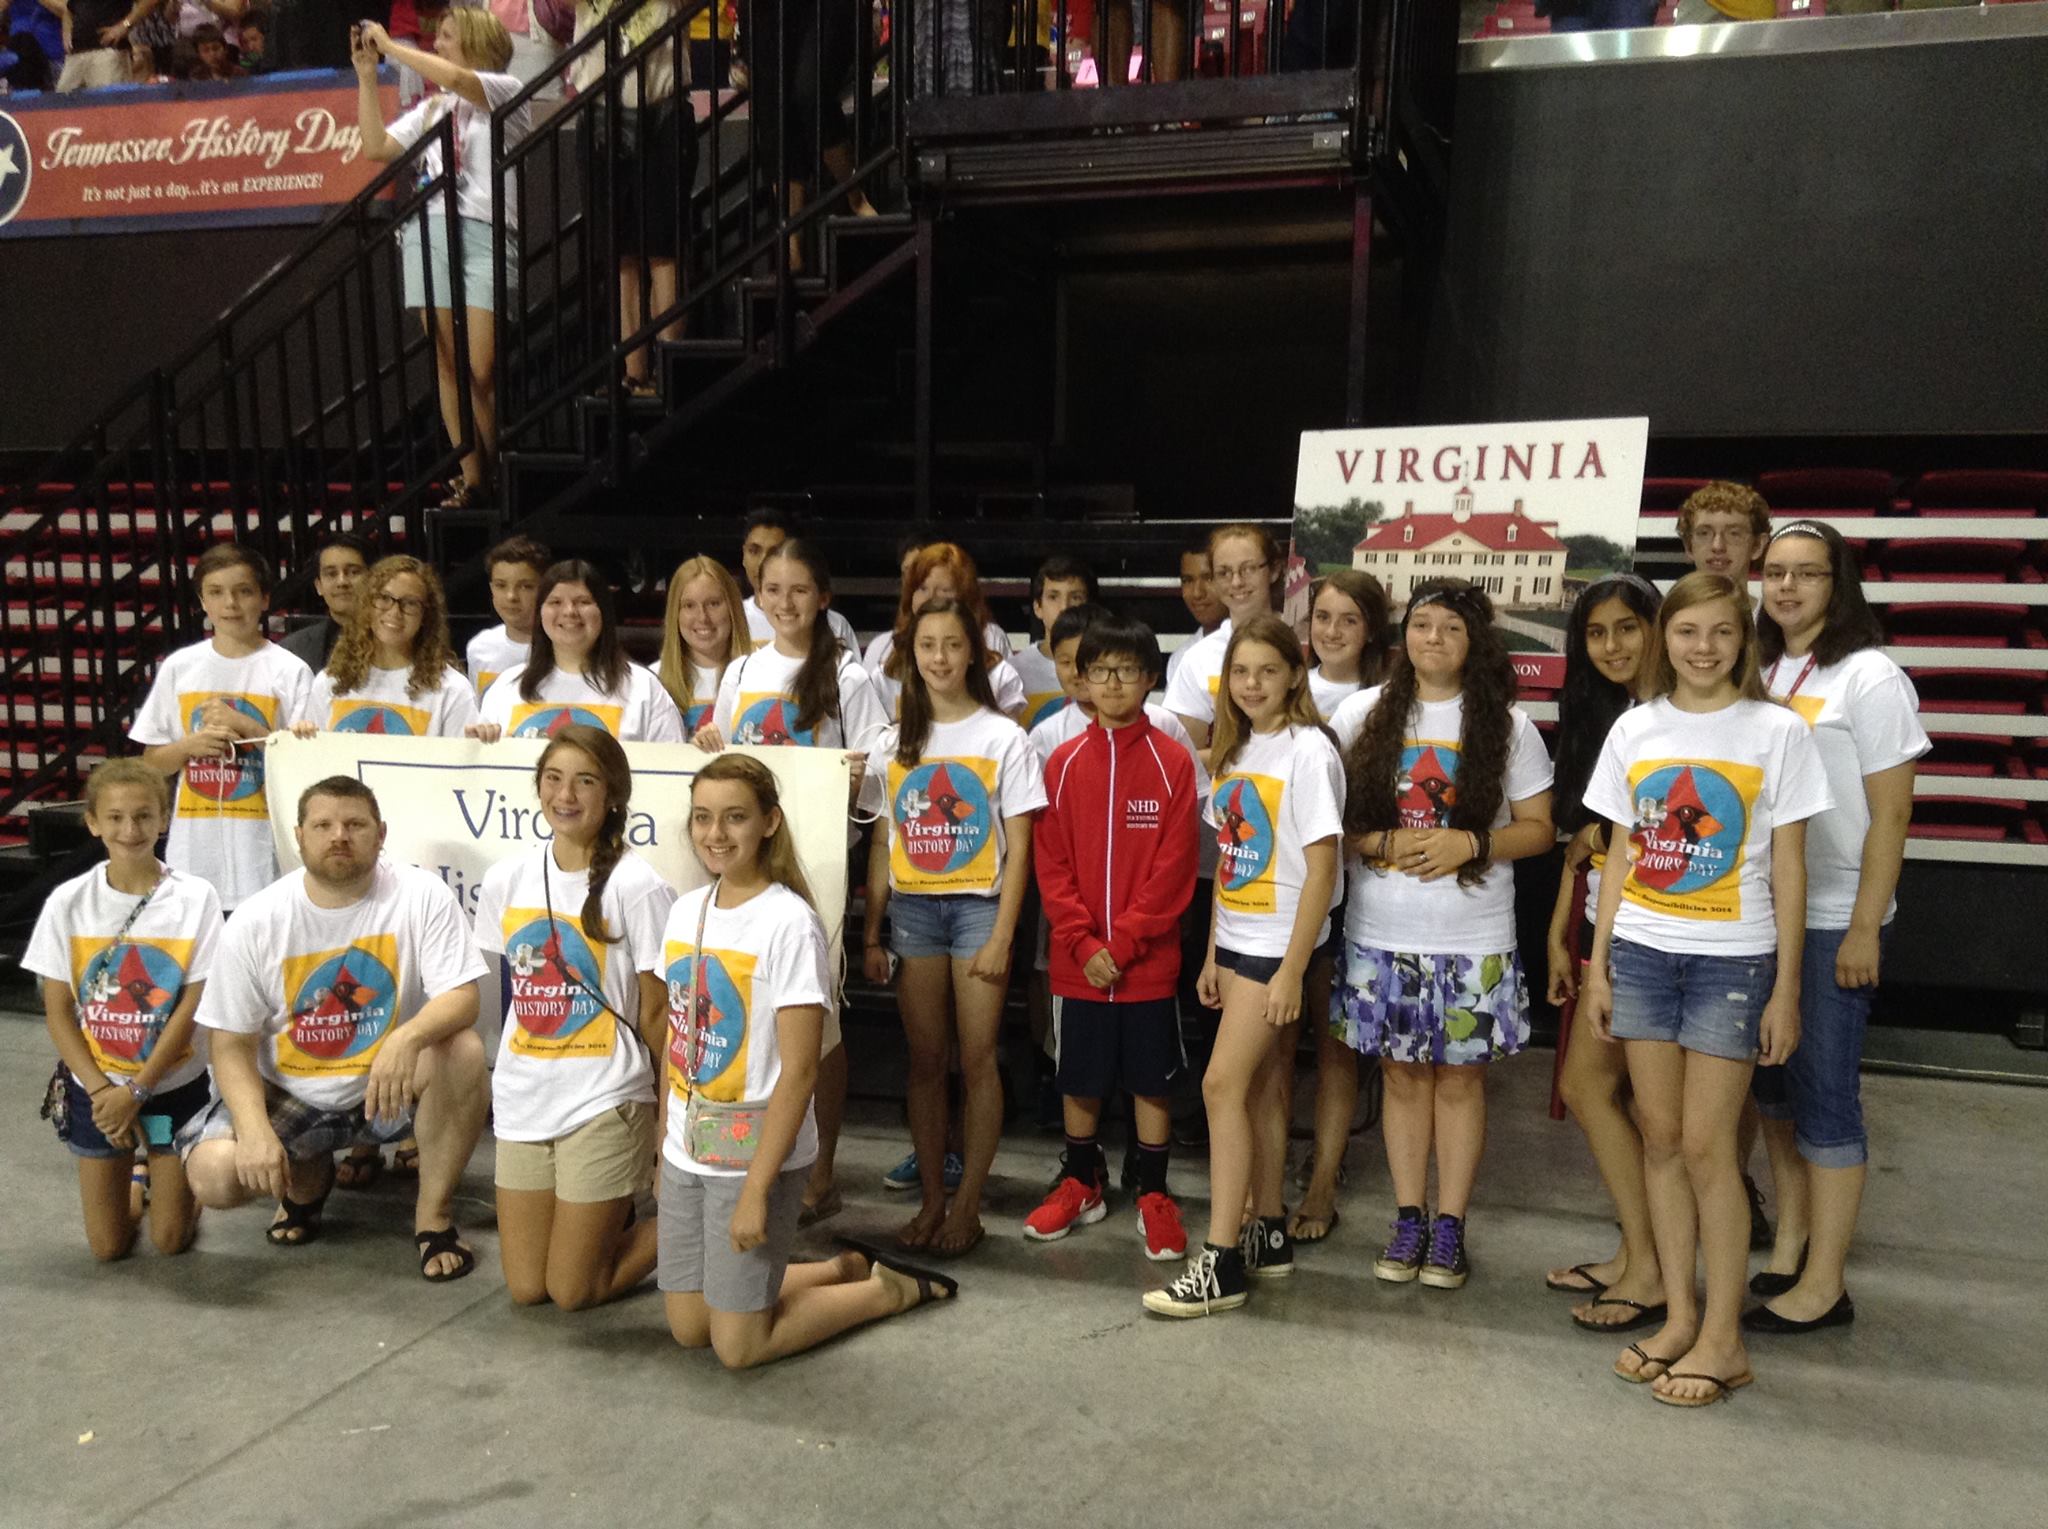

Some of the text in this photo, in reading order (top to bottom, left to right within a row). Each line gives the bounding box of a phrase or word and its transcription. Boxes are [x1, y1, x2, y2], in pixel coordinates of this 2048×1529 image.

[41, 107, 364, 170] Tennessee History Day
[83, 186, 102, 202] It's
[104, 186, 126, 200] not
[127, 184, 151, 203] just
[154, 186, 162, 198] a
[222, 181, 239, 194] an
[242, 171, 324, 192] EXPERIENCE!
[1336, 441, 1607, 485] VIRGINIA
[1126, 799, 1160, 813] NHD
[904, 819, 980, 836] Virginia
[908, 838, 951, 855] HISTORY
[515, 999, 599, 1017] HISTORY DAY
[295, 1020, 380, 1043] HISTORY DAY
